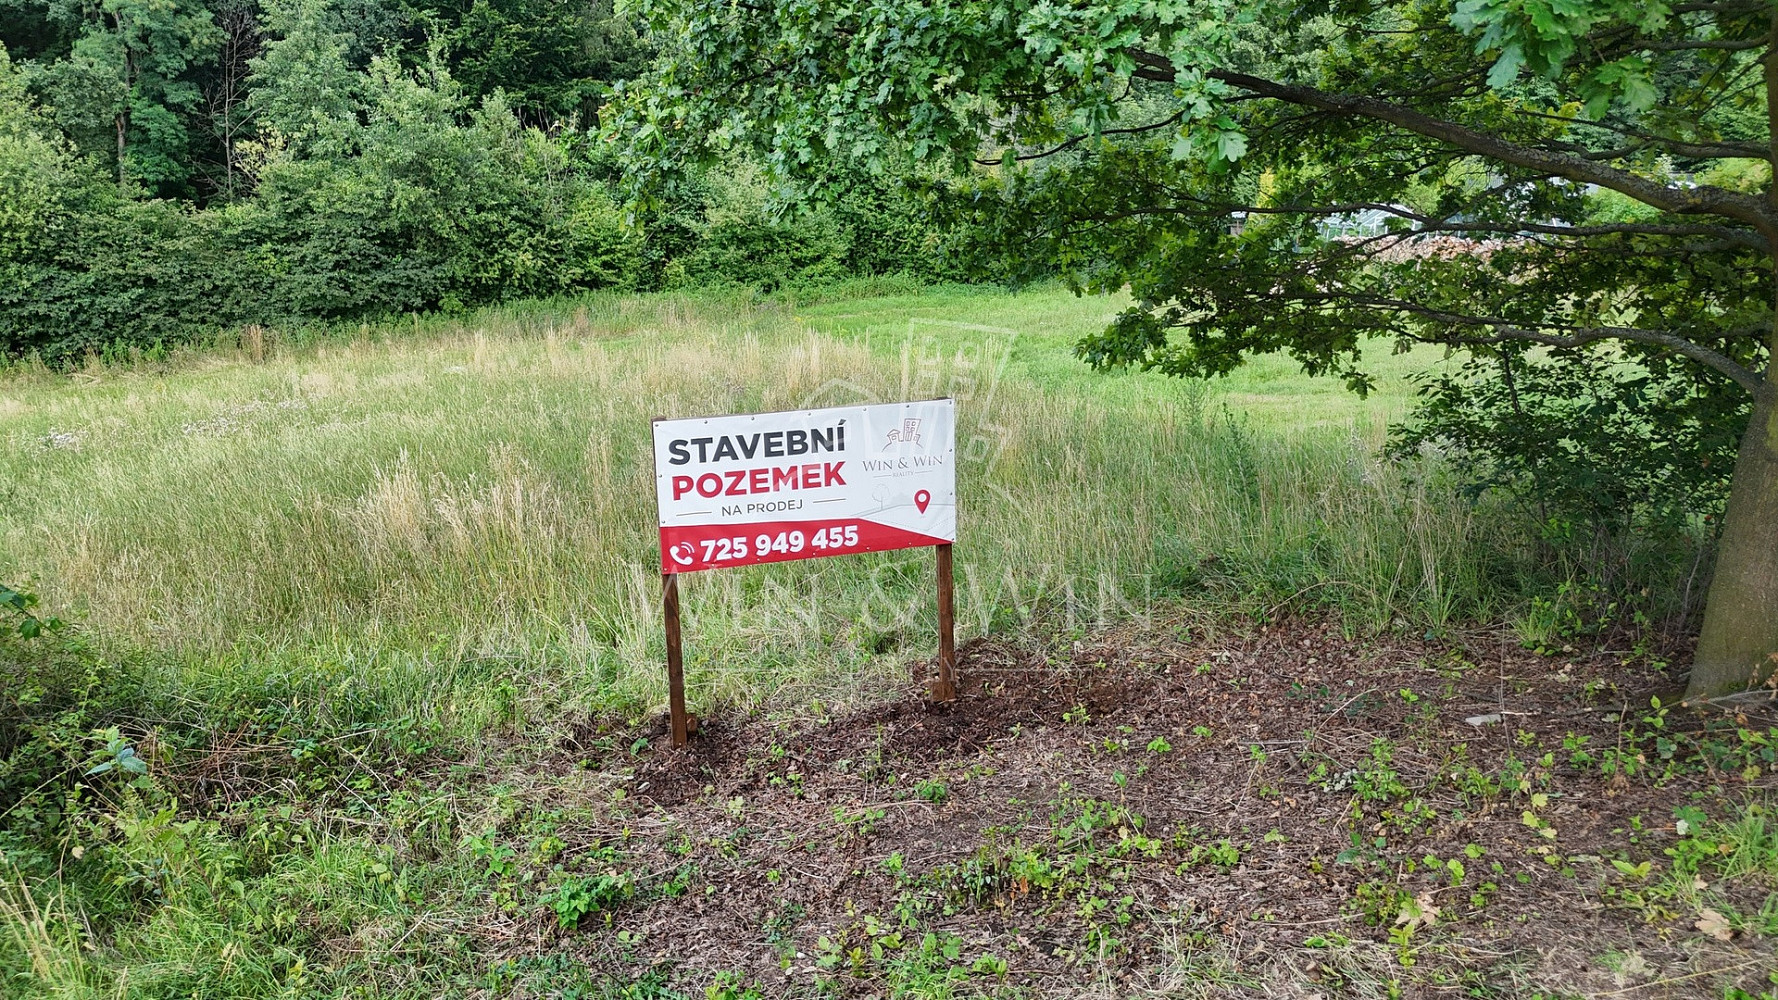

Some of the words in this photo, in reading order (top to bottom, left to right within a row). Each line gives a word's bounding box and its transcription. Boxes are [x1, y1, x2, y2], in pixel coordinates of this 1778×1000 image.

[668, 418, 846, 465] STAVEBNÍ
[672, 461, 847, 501] POZEMEK
[862, 459, 893, 471] WIN
[898, 457, 909, 469] &
[913, 455, 943, 467] WIN
[721, 505, 743, 517] NA
[747, 499, 803, 513] PRODEJ
[700, 537, 748, 562] 725
[755, 531, 805, 556] 949
[811, 525, 859, 549] 455
